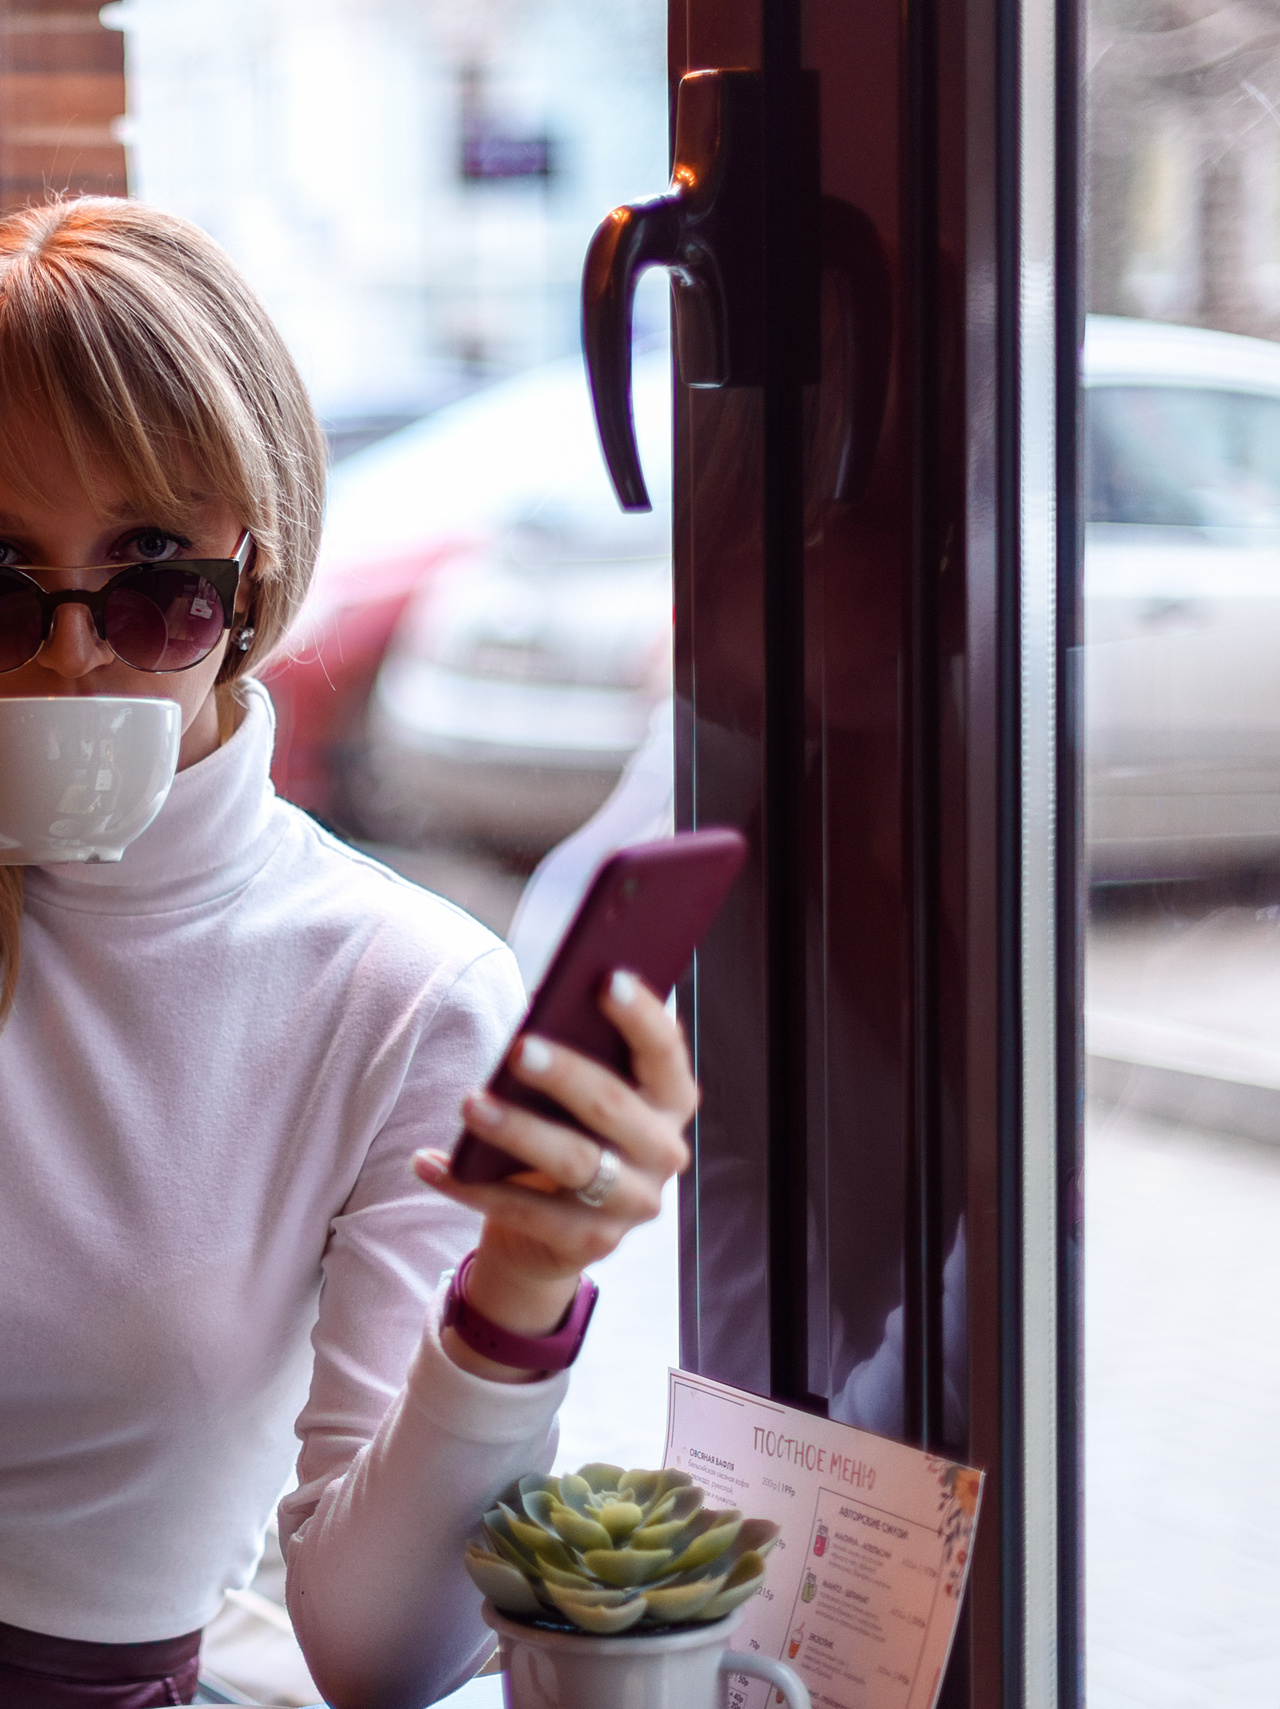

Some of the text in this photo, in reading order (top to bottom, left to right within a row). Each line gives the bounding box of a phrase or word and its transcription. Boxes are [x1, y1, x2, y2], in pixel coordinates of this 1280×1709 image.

[689, 1448, 735, 1471] ОВСЯНАЯ ВАФЛЯ
[753, 1426, 877, 1491] ПОСТНОЕ МЕНЮ
